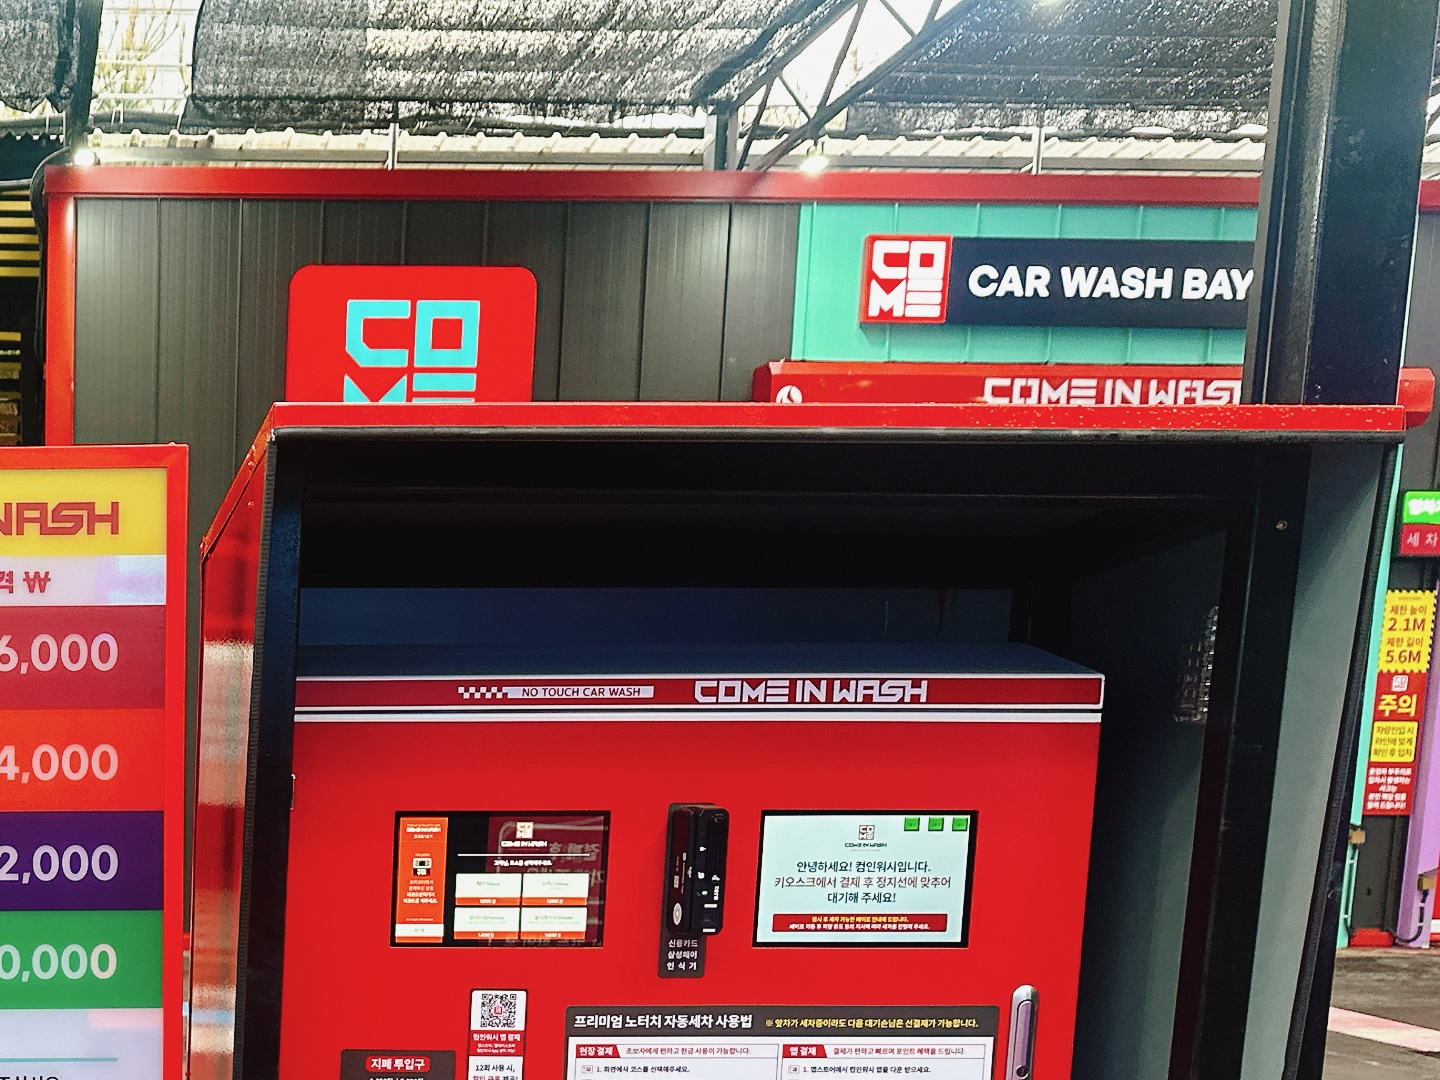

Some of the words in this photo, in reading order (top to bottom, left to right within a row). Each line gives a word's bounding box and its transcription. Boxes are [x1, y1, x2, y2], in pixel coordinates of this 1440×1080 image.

[872, 240, 947, 280] CO
[969, 265, 1050, 297] CAR
[1061, 267, 1173, 299] WASH
[1182, 268, 1254, 300] BAY
[868, 278, 943, 318] ME
[984, 377, 1097, 405] COME
[1103, 378, 1146, 405] IN
[1388, 618, 1425, 631] 2.1M
[1386, 650, 1421, 663] 5.6M
[522, 687, 539, 698] NO
[541, 687, 579, 698] TOUCH
[582, 687, 606, 699] CAR
[608, 688, 641, 699] WASH
[694, 680, 789, 703] COME
[796, 680, 825, 703] IN
[832, 680, 928, 703] WASH
[1378, 694, 1417, 717] 주의
[827, 892, 858, 903] 대기해
[861, 893, 895, 903] 주세요!
[574, 1015, 622, 1028] 프리미엄
[625, 1015, 661, 1028] 노터치
[664, 1015, 713, 1028] 자동세차
[715, 1015, 752, 1028] 사용법
[371, 1058, 391, 1069] 지폐
[394, 1058, 425, 1071] 투입구
